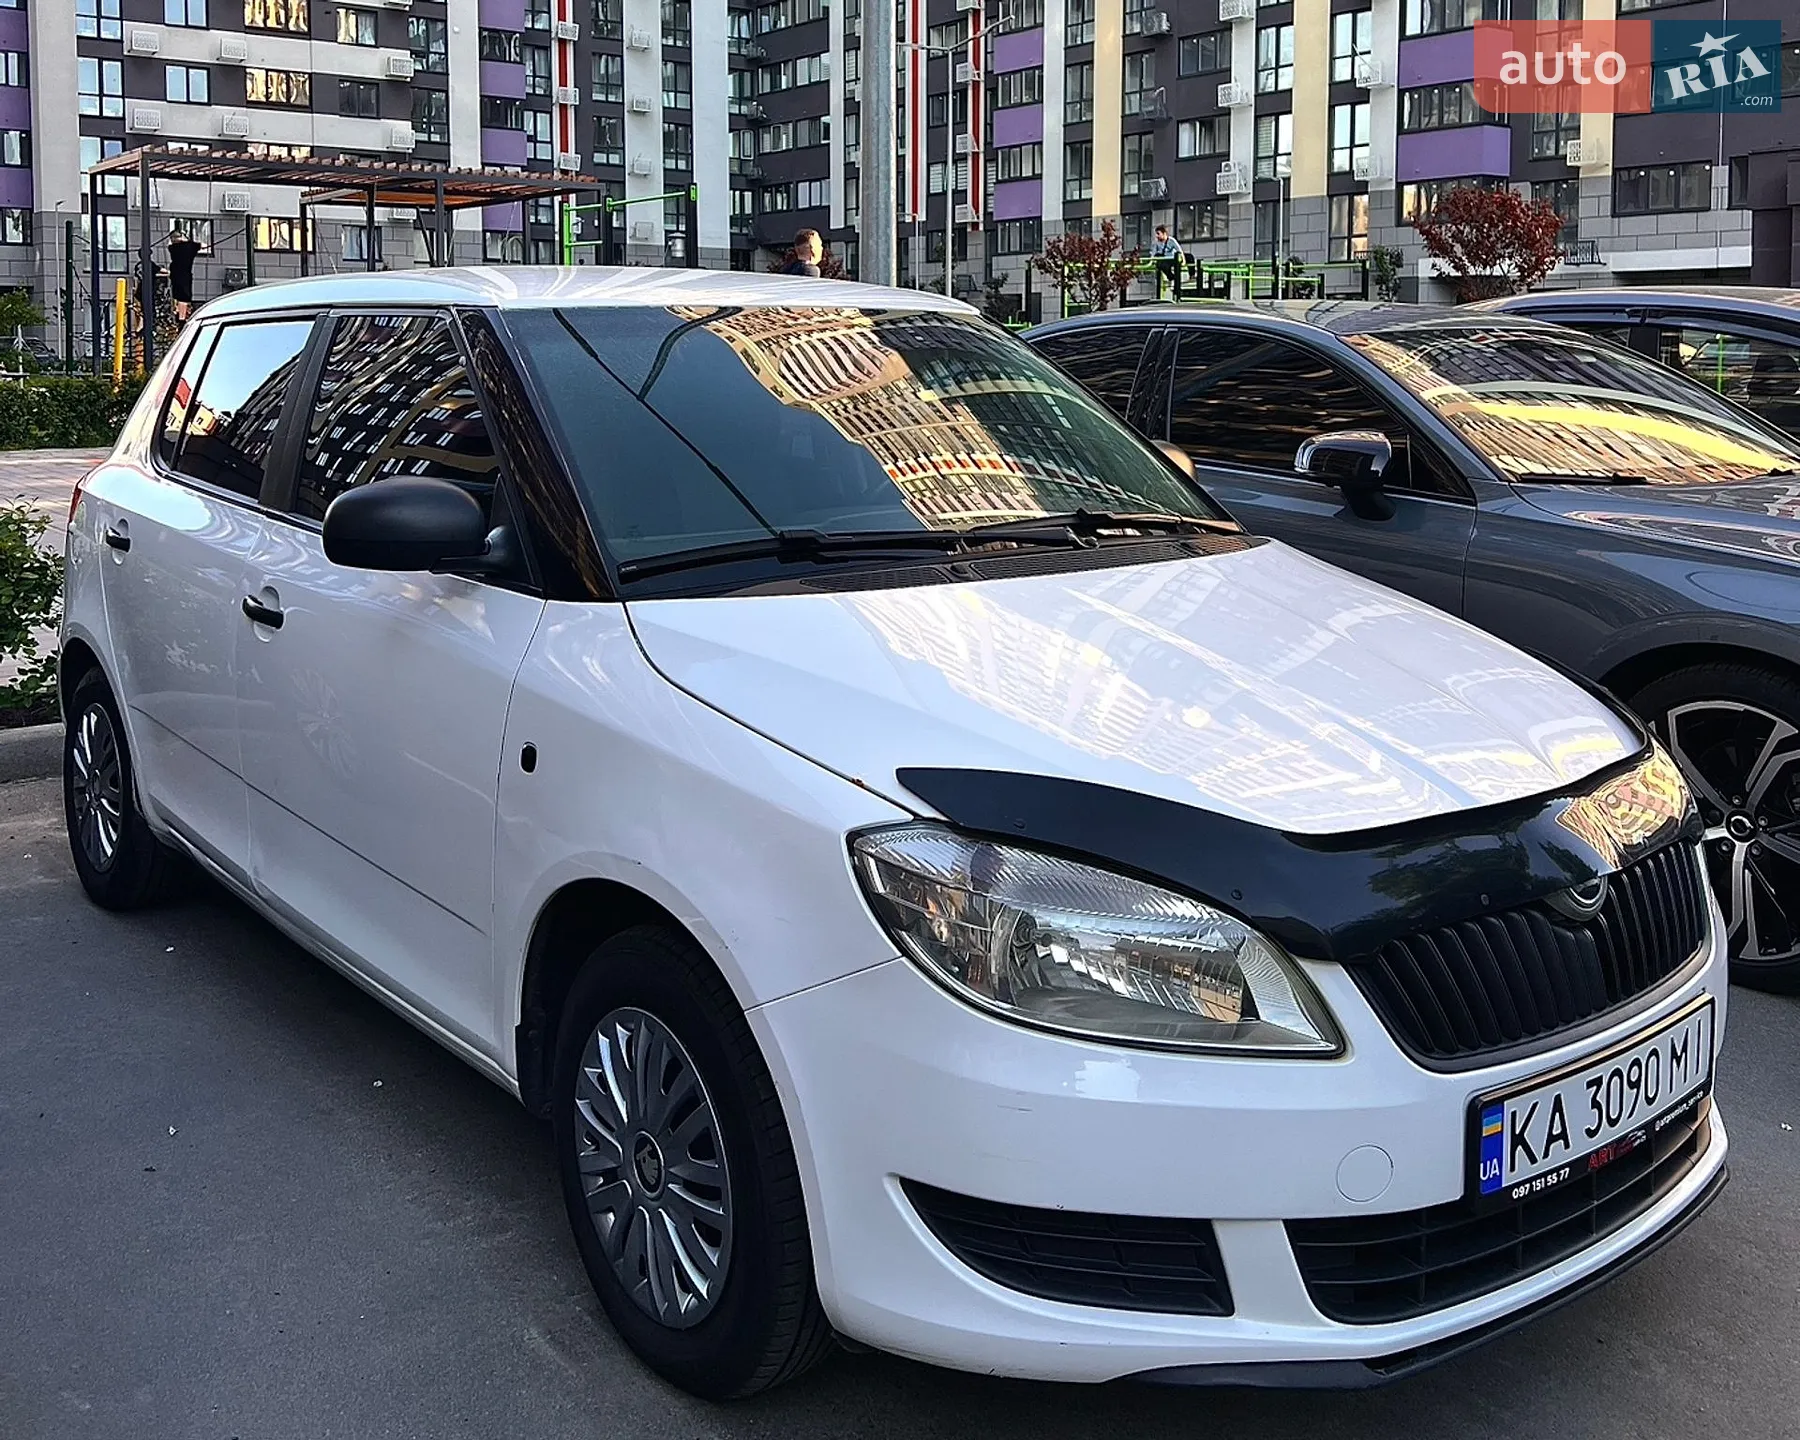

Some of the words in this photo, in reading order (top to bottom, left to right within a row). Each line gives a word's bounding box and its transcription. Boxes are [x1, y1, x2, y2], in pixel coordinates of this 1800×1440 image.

[1509, 1093, 1571, 1173] KA
[1584, 1048, 1660, 1139] 3090
[1669, 1018, 1702, 1094] MI
[1480, 1157, 1500, 1181] UA
[1588, 1144, 1617, 1169] ART
[1512, 1183, 1530, 1199] 097
[1532, 1177, 1545, 1192] 151
[1546, 1173, 1558, 1186] 55
[1559, 1167, 1570, 1181] 77
